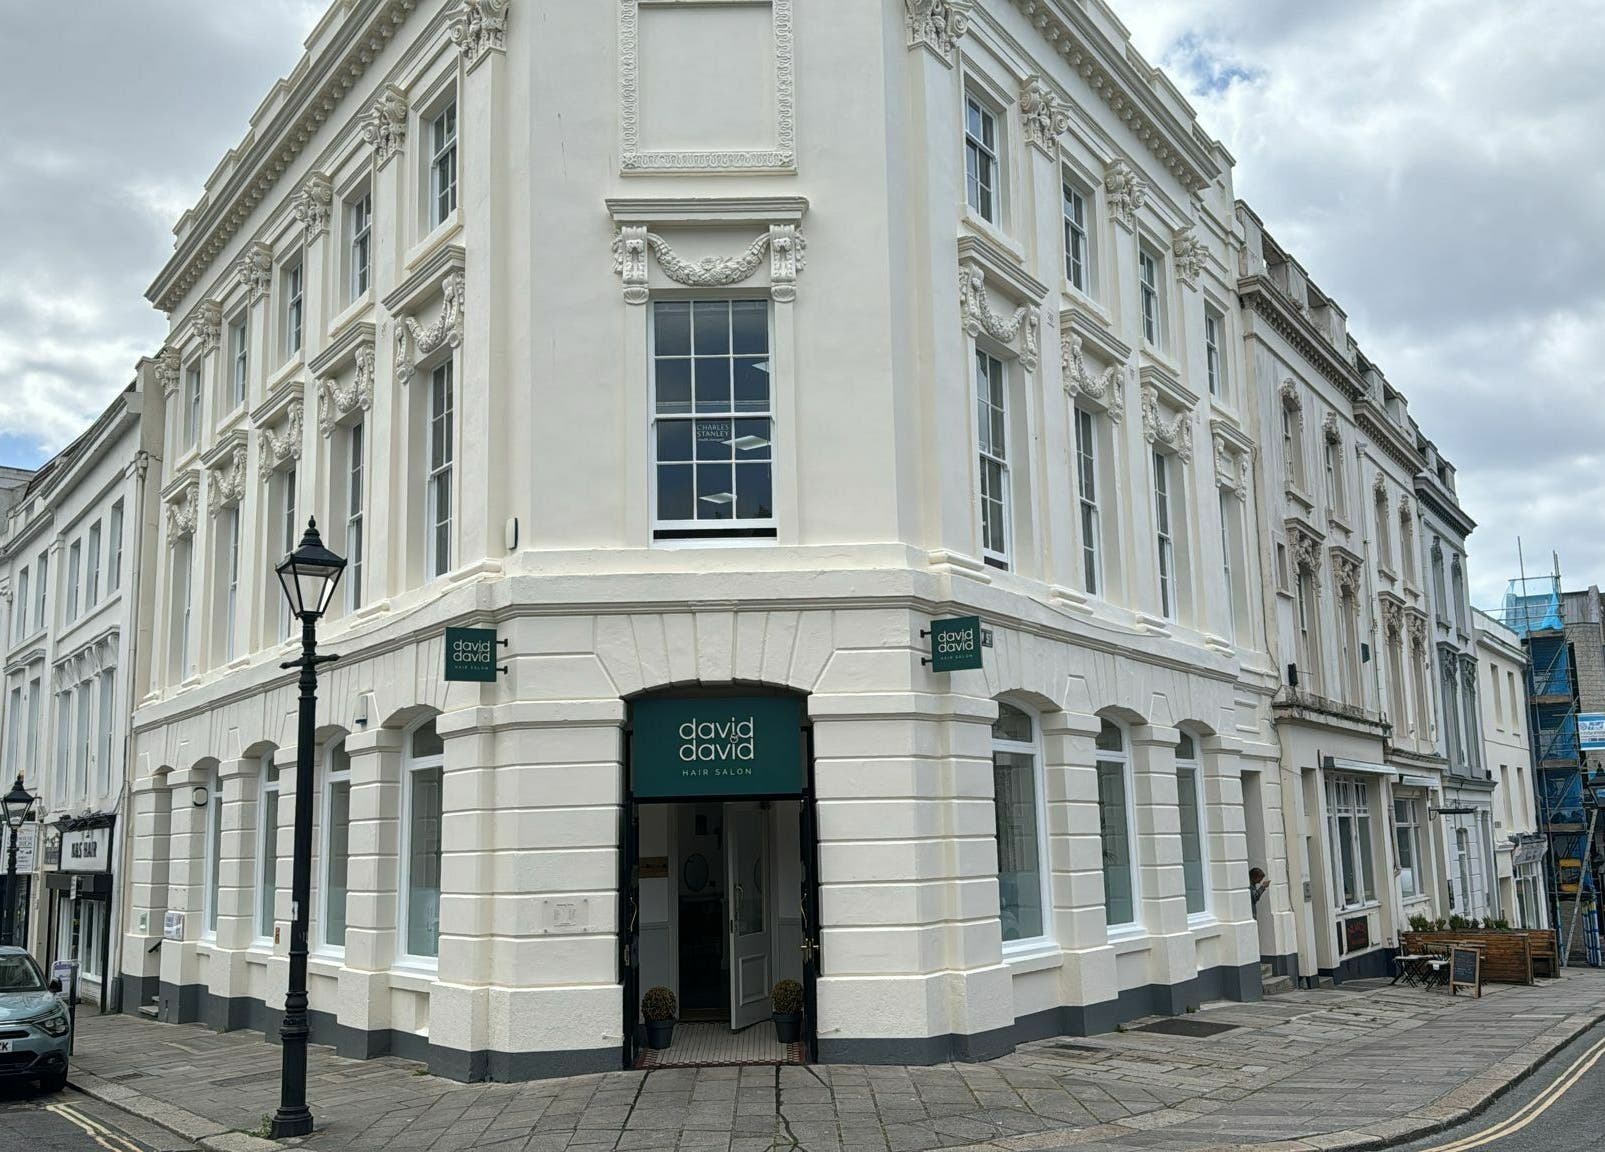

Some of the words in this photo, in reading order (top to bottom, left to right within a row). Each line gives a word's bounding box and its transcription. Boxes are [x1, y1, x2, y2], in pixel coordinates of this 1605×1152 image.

[696, 423, 730, 431] CHARLES
[696, 430, 730, 438] STANLEY
[937, 628, 974, 642] david
[453, 639, 490, 652] david
[938, 639, 974, 653] david
[453, 650, 490, 662] david
[679, 716, 754, 739] david
[679, 738, 755, 761] david
[682, 769, 709, 777] HAIR
[714, 767, 752, 776] SALON
[83, 841, 98, 858] HAIR
